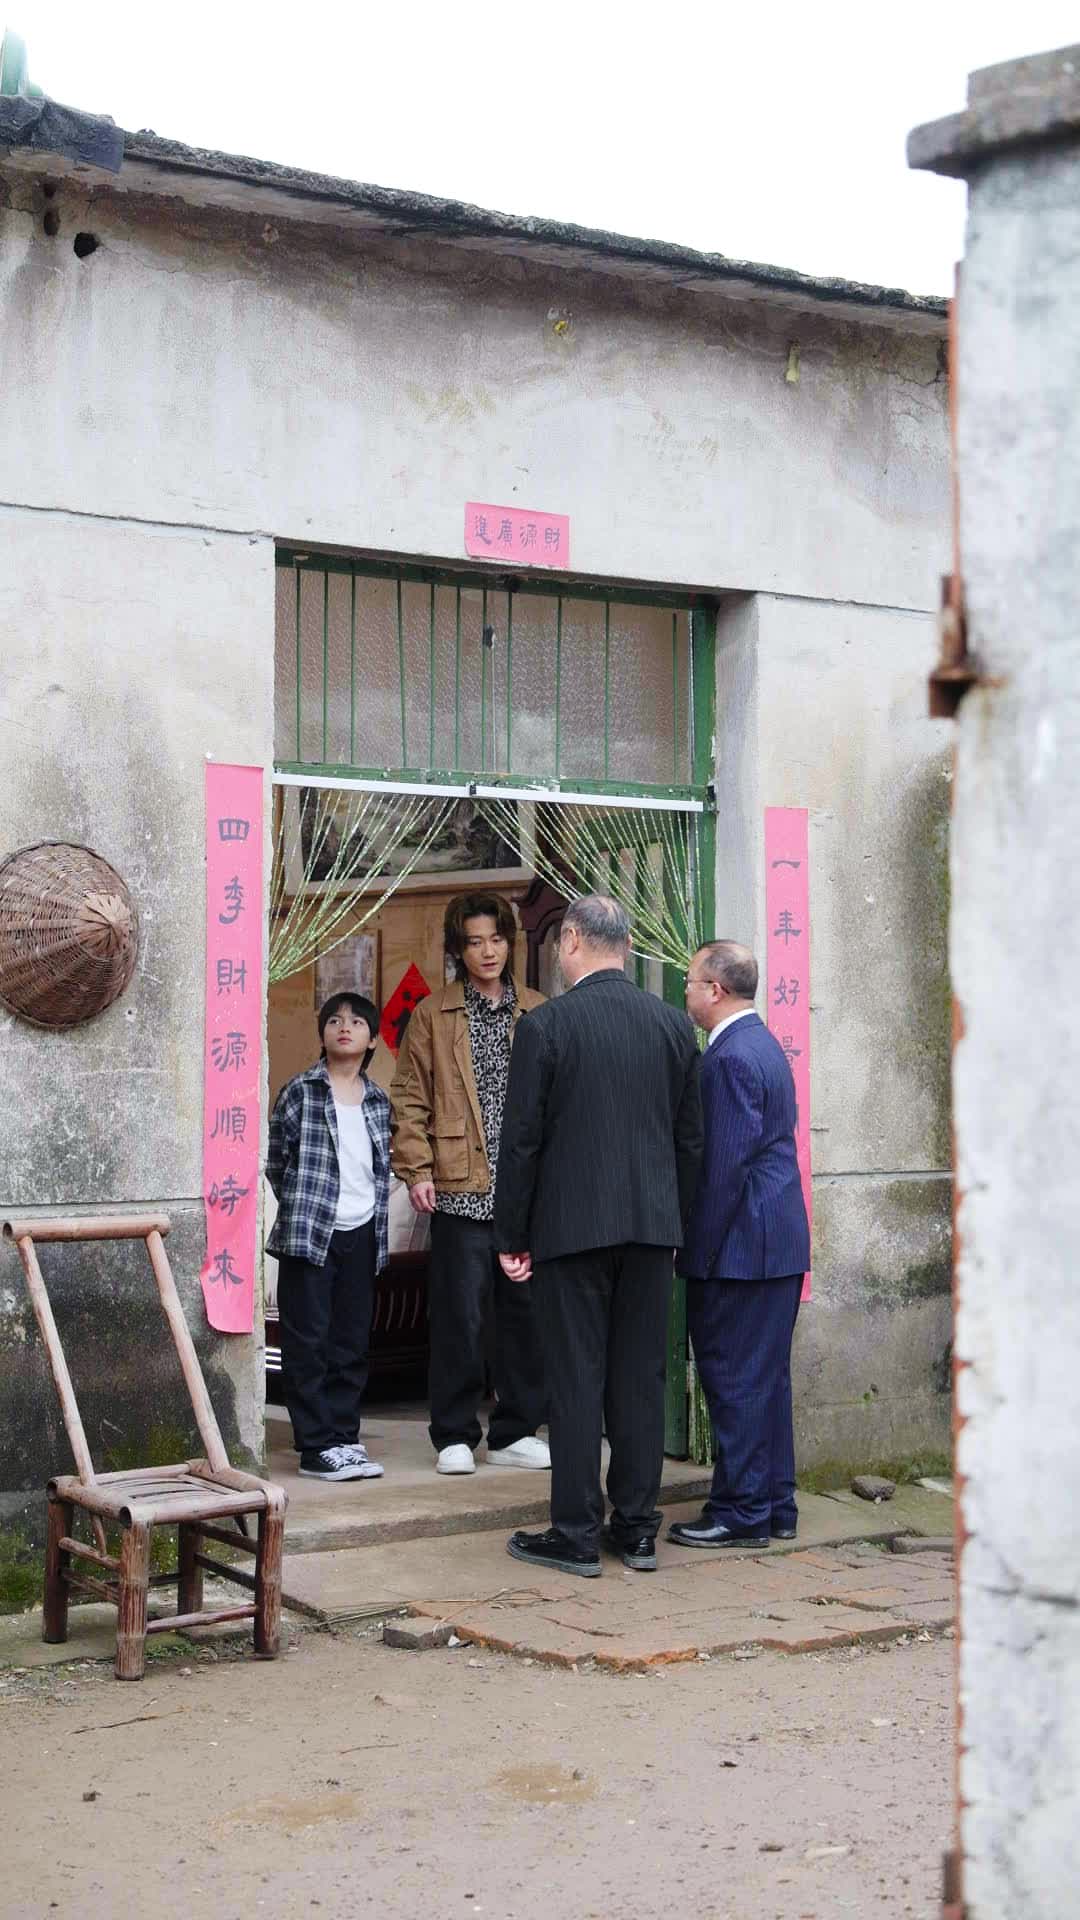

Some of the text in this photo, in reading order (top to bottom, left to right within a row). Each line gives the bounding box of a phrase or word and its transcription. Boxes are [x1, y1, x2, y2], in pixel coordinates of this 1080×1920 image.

[208, 818, 250, 1291] 四季財源順時來
